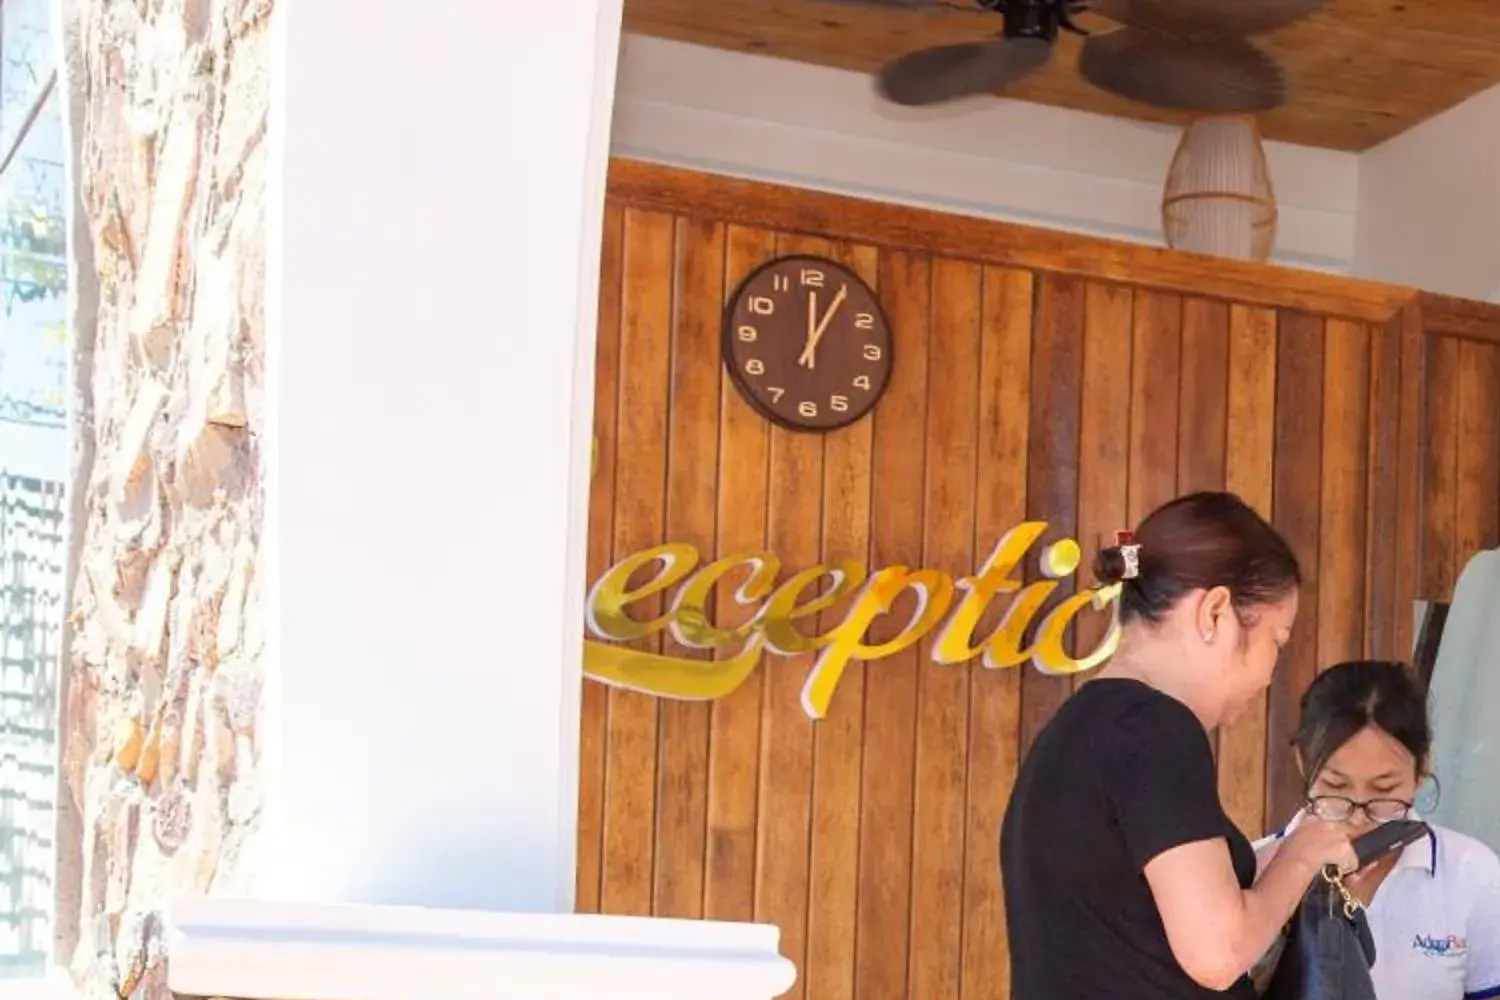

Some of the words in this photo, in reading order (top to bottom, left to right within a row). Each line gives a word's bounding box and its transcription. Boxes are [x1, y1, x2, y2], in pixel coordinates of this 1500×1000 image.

[773, 273, 789, 292] 11
[801, 268, 825, 288] 12
[748, 295, 775, 315] 10
[854, 313, 874, 329] 2
[737, 325, 758, 342] 9
[863, 344, 881, 361] 3
[744, 358, 765, 375] 8
[852, 375, 871, 391] 4
[767, 386, 785, 404] 7
[830, 395, 849, 411] 5
[798, 401, 818, 417] 6
[583, 520, 1124, 720] eceptio
